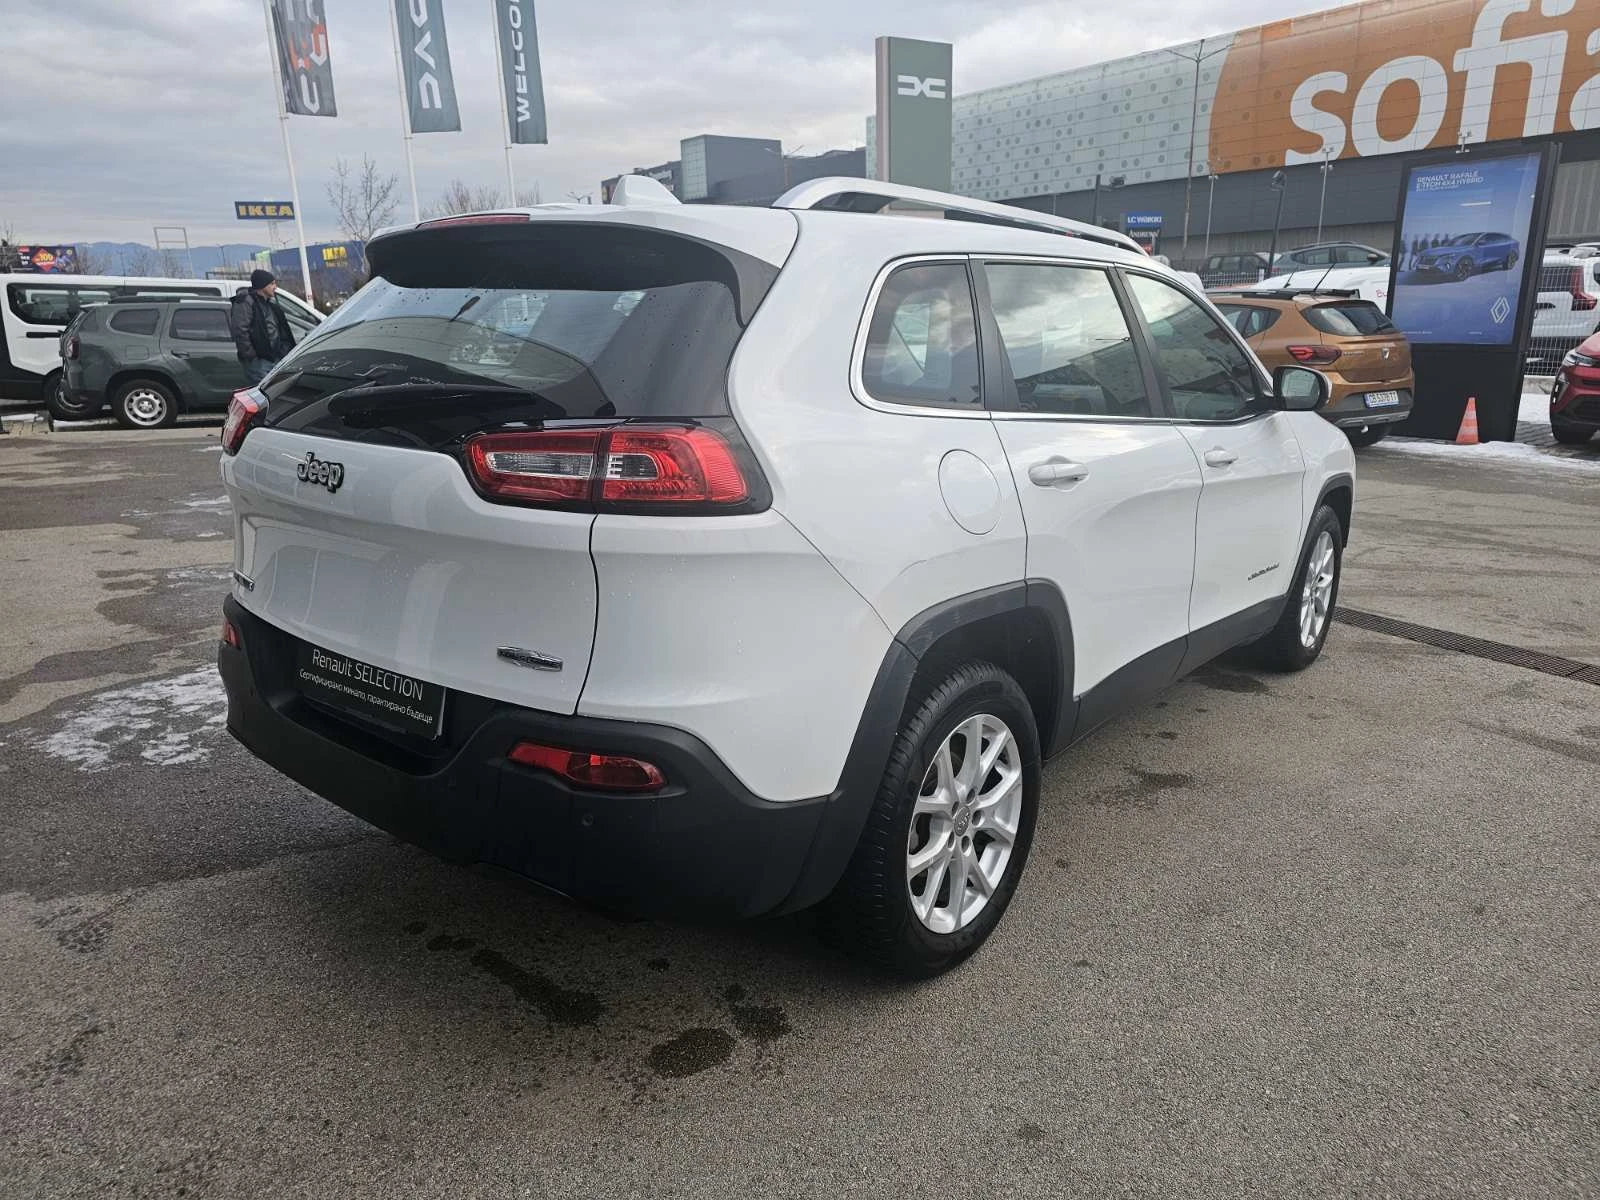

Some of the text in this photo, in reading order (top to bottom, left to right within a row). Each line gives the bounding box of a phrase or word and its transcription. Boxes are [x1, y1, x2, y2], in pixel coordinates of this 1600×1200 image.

[509, 0, 531, 122] WELCO
[1417, 174, 1449, 183] RENAULT
[239, 205, 293, 217] IKEA
[297, 451, 344, 494] Jeep
[299, 668, 433, 725] Сертифицирано минало, гарантирано бъдеще
[312, 648, 424, 701] Renault SELECTION
